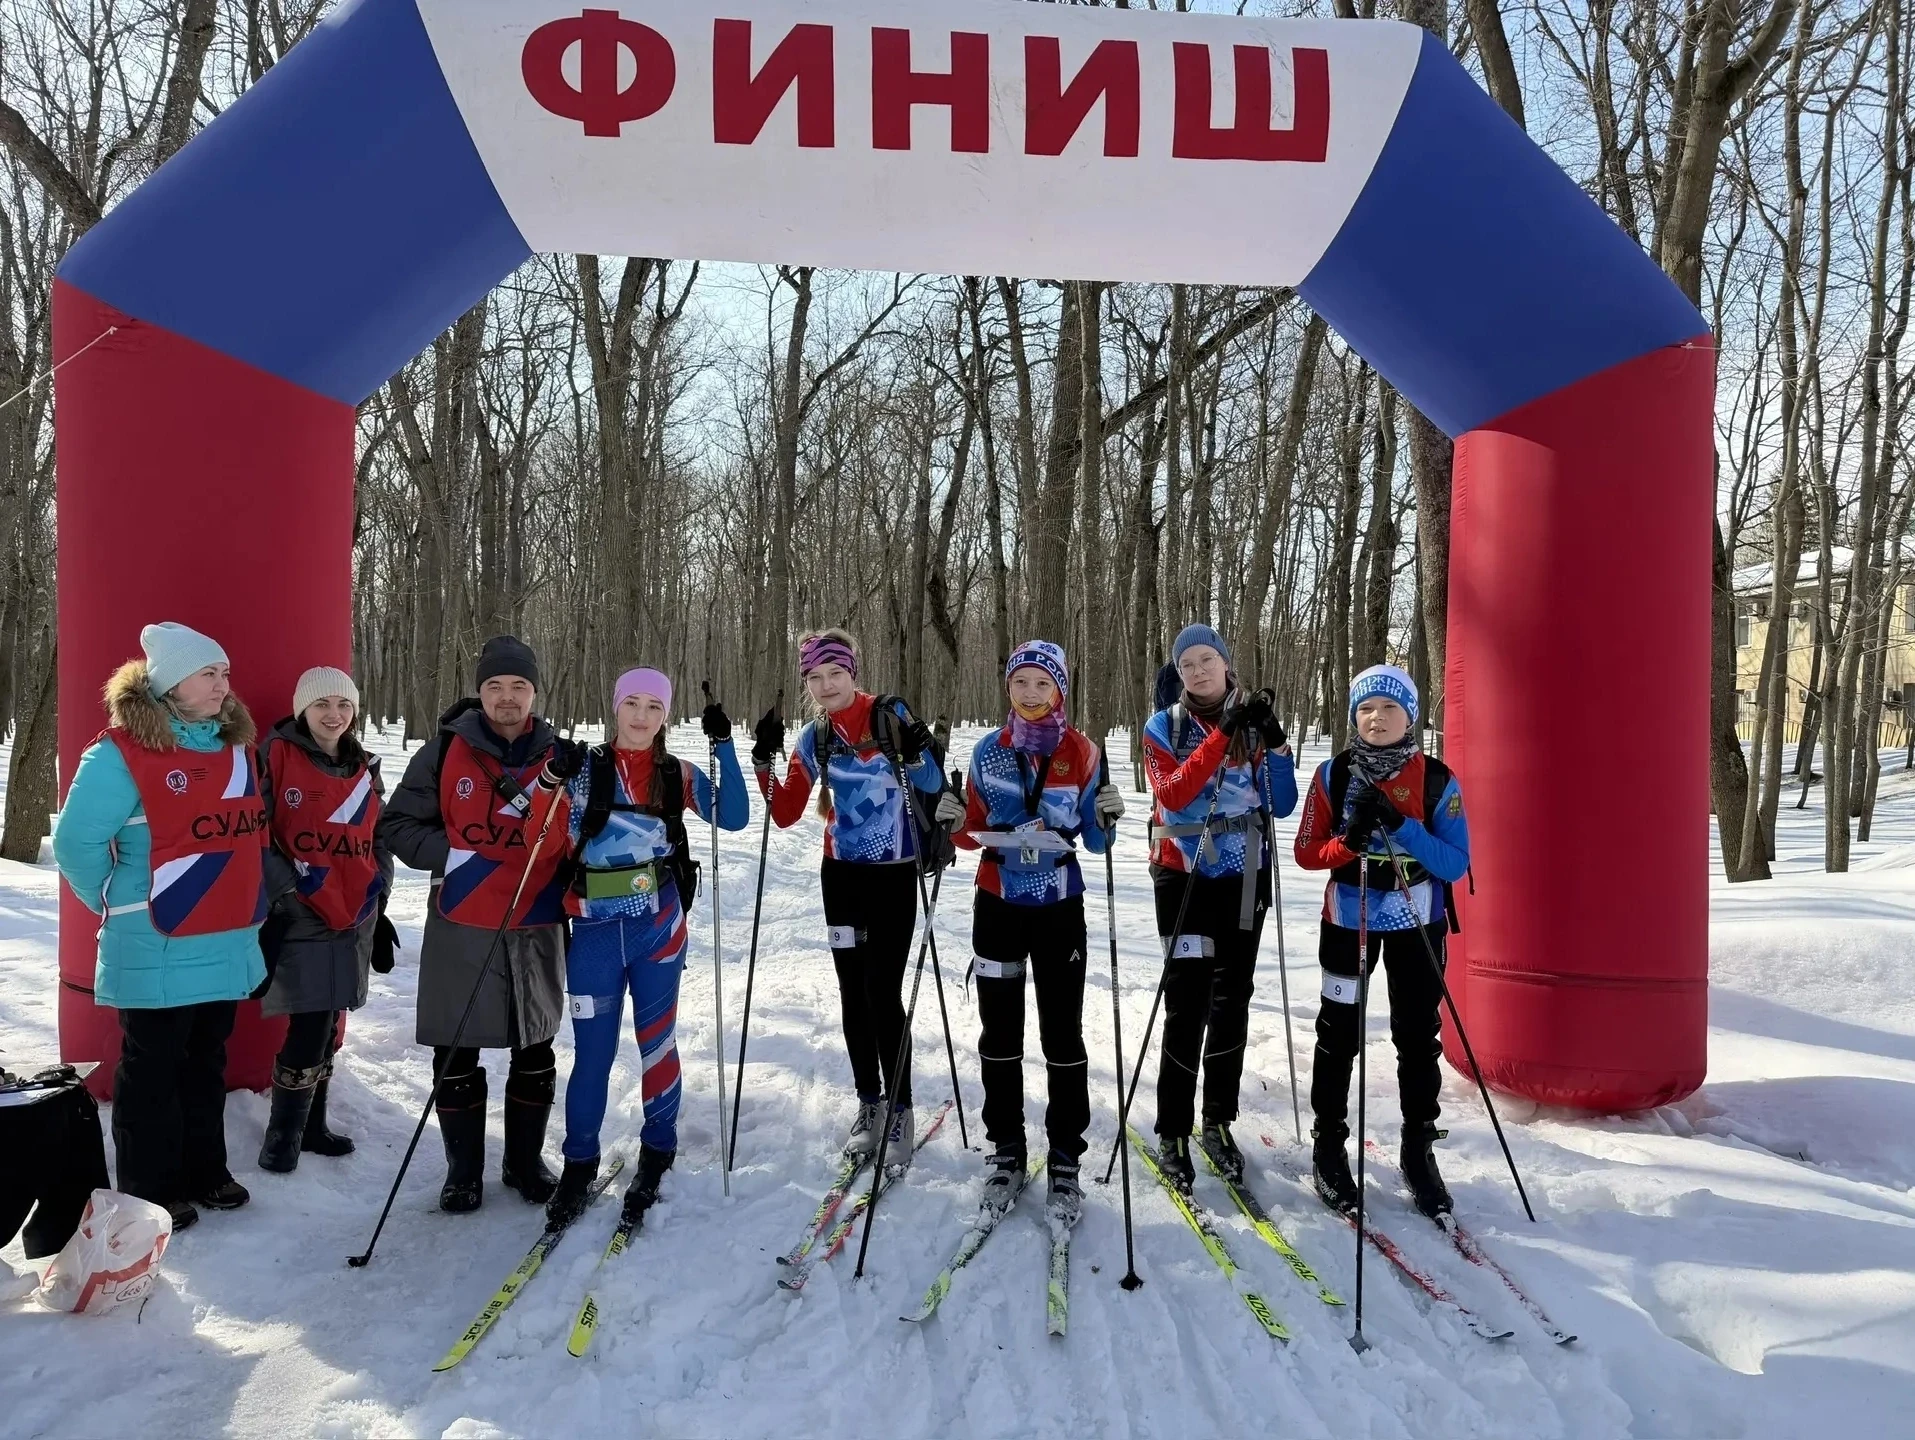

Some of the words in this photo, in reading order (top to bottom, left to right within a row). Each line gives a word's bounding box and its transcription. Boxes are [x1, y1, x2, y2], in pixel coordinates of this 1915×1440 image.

[521, 8, 1330, 162] ФИНИШ
[767, 752, 776, 801] NORDWAY
[900, 766, 912, 815] NORDWAY
[191, 809, 269, 840] СУДЬЯ
[462, 823, 525, 849] СУД
[294, 831, 372, 861] СУДЬЯ
[834, 931, 841, 942] 9
[1182, 941, 1190, 952] 9
[1334, 984, 1342, 996] 9
[574, 1002, 581, 1013] 9
